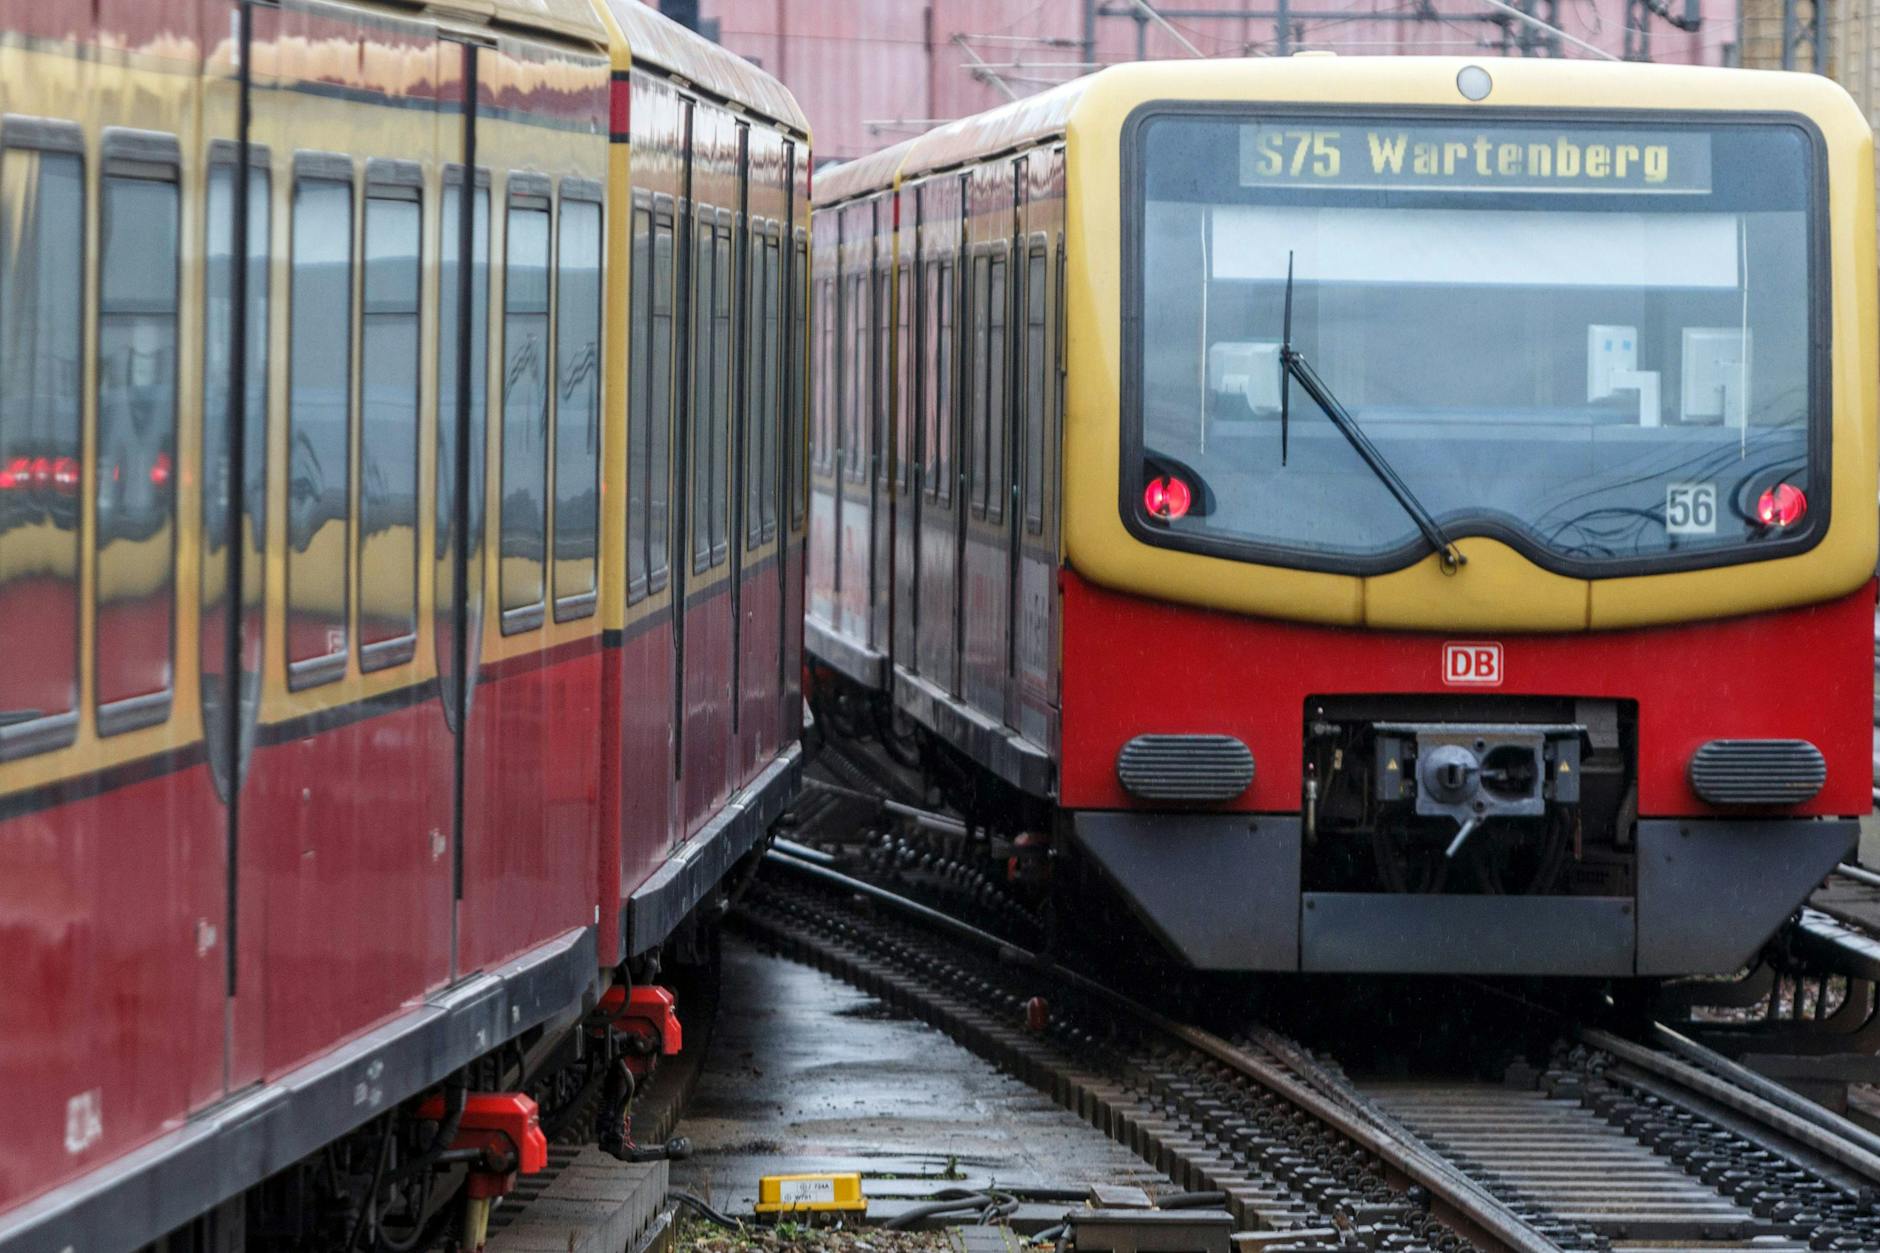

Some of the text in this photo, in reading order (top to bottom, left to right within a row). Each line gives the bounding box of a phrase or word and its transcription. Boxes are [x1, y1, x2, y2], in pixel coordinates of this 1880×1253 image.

[1256, 130, 1669, 183] S75 Wartenberg
[1670, 489, 1713, 527] 56
[1452, 650, 1495, 677] DB
